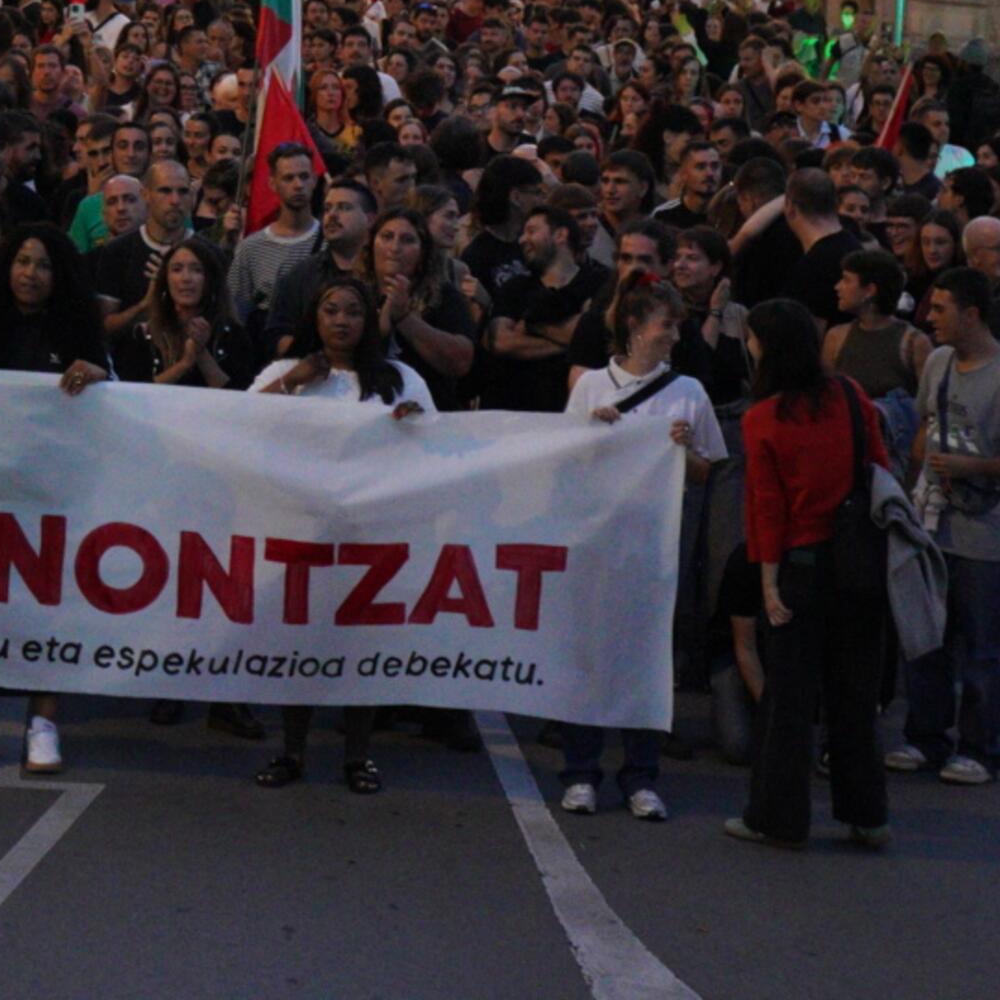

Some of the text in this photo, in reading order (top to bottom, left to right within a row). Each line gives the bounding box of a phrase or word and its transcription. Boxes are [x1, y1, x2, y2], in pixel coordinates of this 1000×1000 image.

[21, 635, 81, 666] eta
[93, 646, 344, 679] espekulazioa
[356, 650, 545, 687] debekatu.
